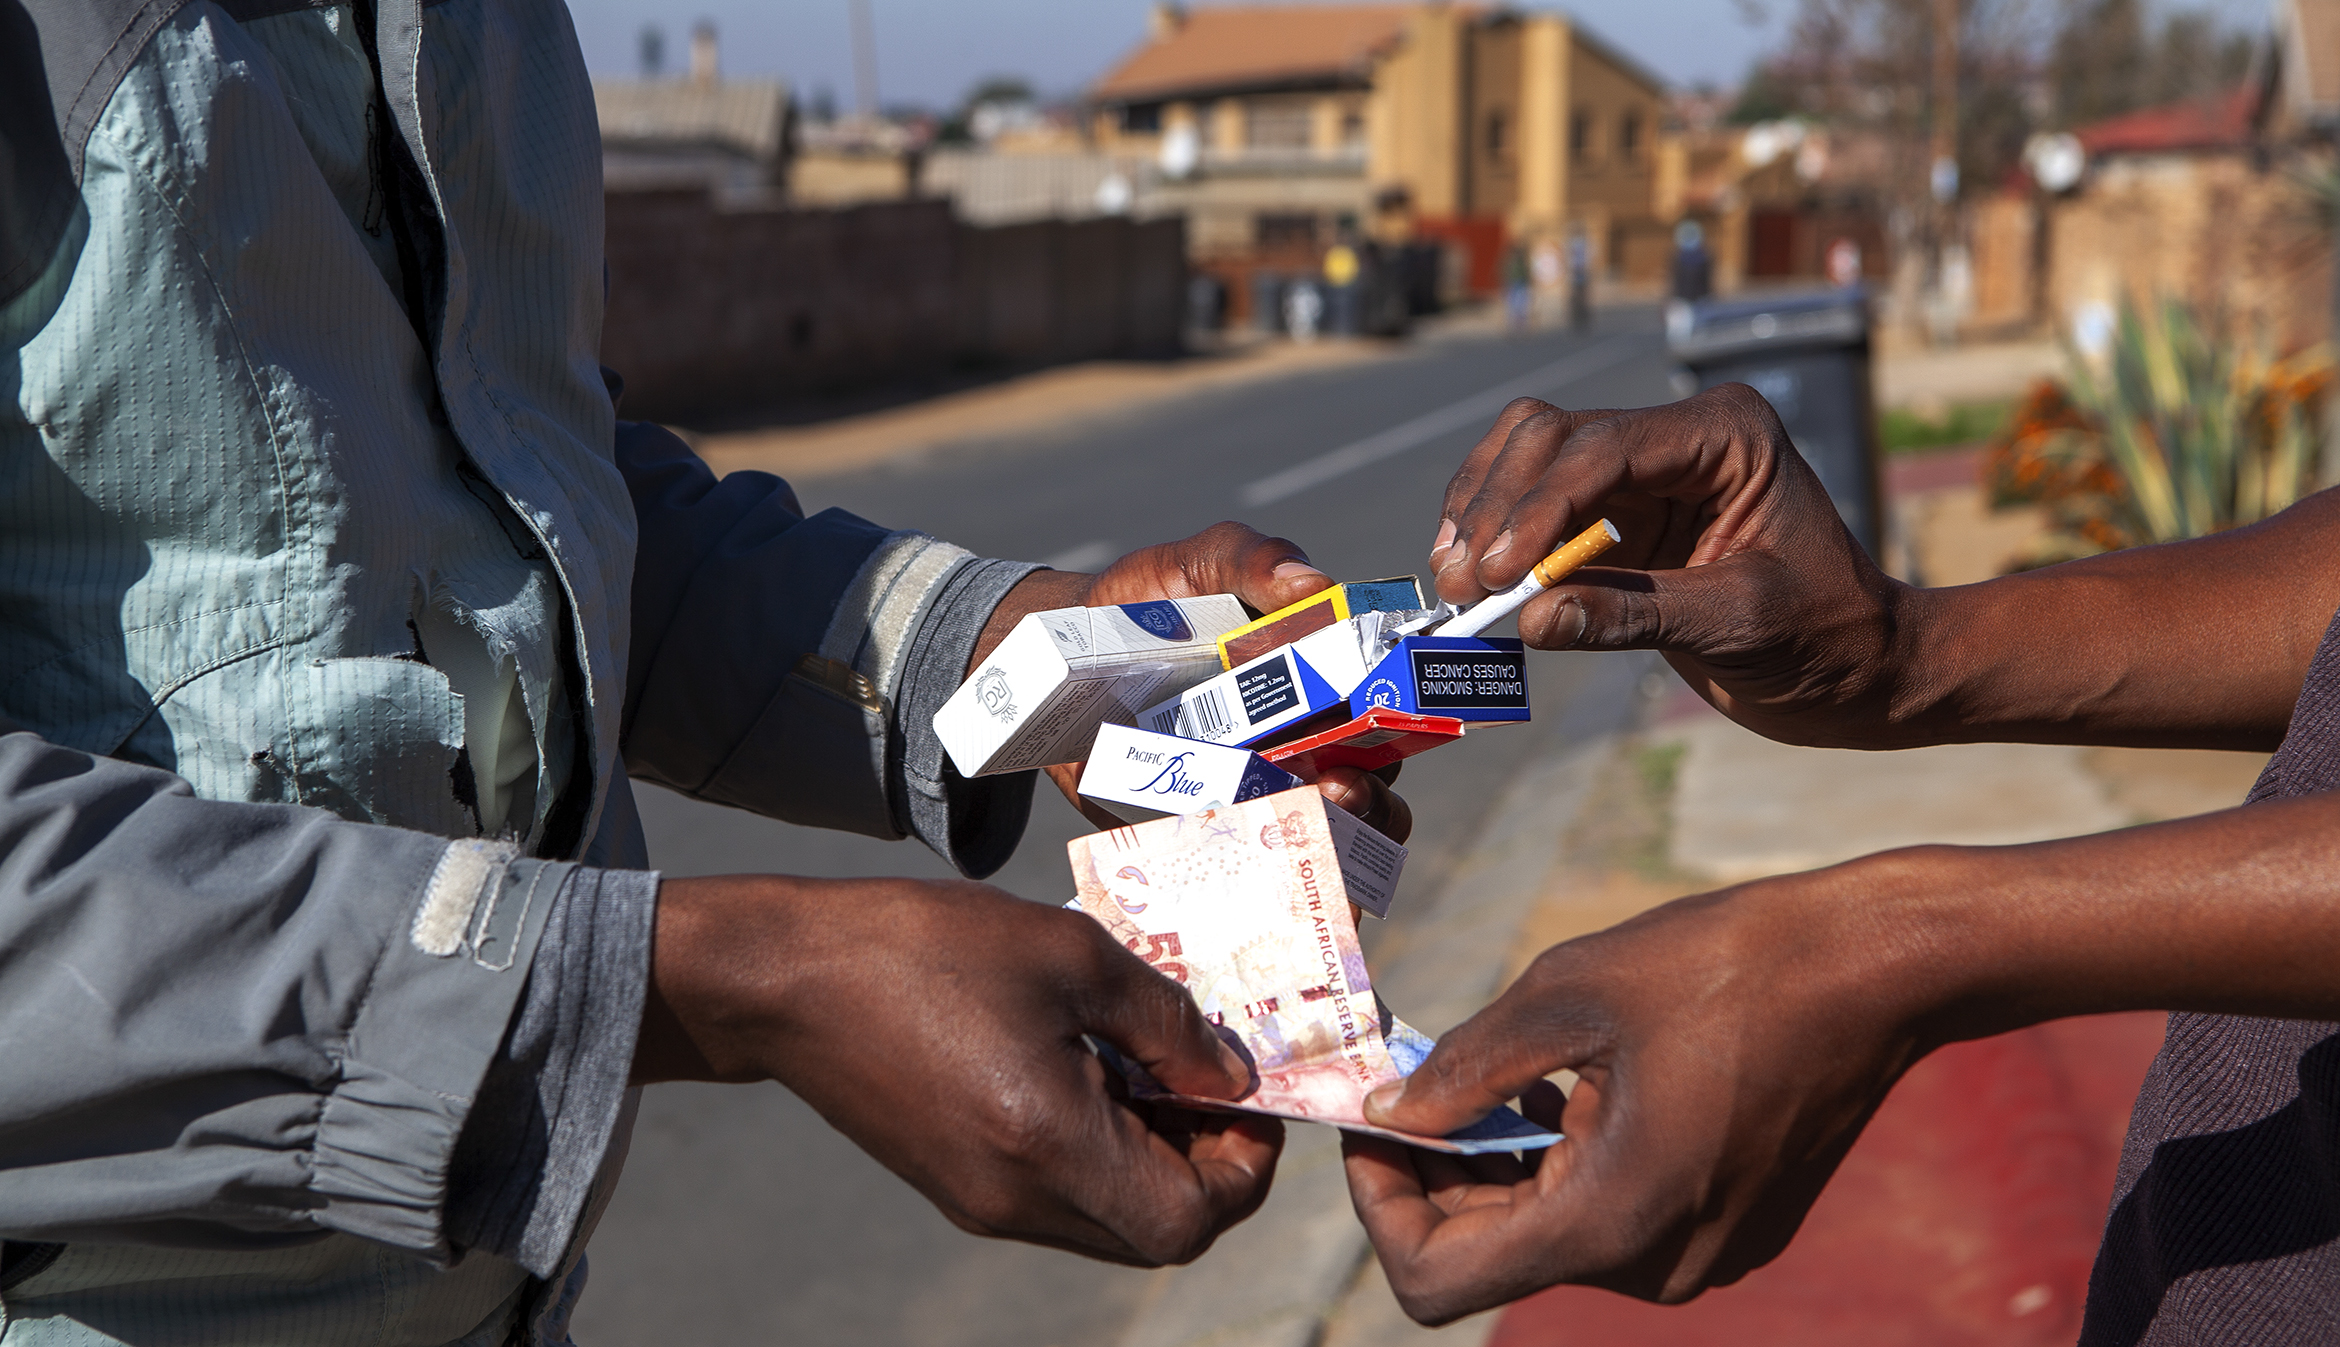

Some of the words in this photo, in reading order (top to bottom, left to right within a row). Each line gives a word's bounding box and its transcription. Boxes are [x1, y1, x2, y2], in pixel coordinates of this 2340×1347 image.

[1424, 663, 1472, 678] CANCER
[1474, 664, 1517, 678] CAUSES
[1260, 682, 1293, 700] Government
[1365, 678, 1386, 701] REDUCED
[1386, 679, 1401, 708] IGNITION
[1422, 680, 1473, 695] SMOKING
[1475, 681, 1522, 695] DANGER:
[1266, 694, 1287, 708] method
[1128, 752, 1204, 796] Blue
[1298, 858, 1322, 912] SOUTH
[1313, 916, 1340, 983] AFRICAN
[1333, 988, 1358, 1050] RESERVE
[1349, 1053, 1372, 1083] BANK
